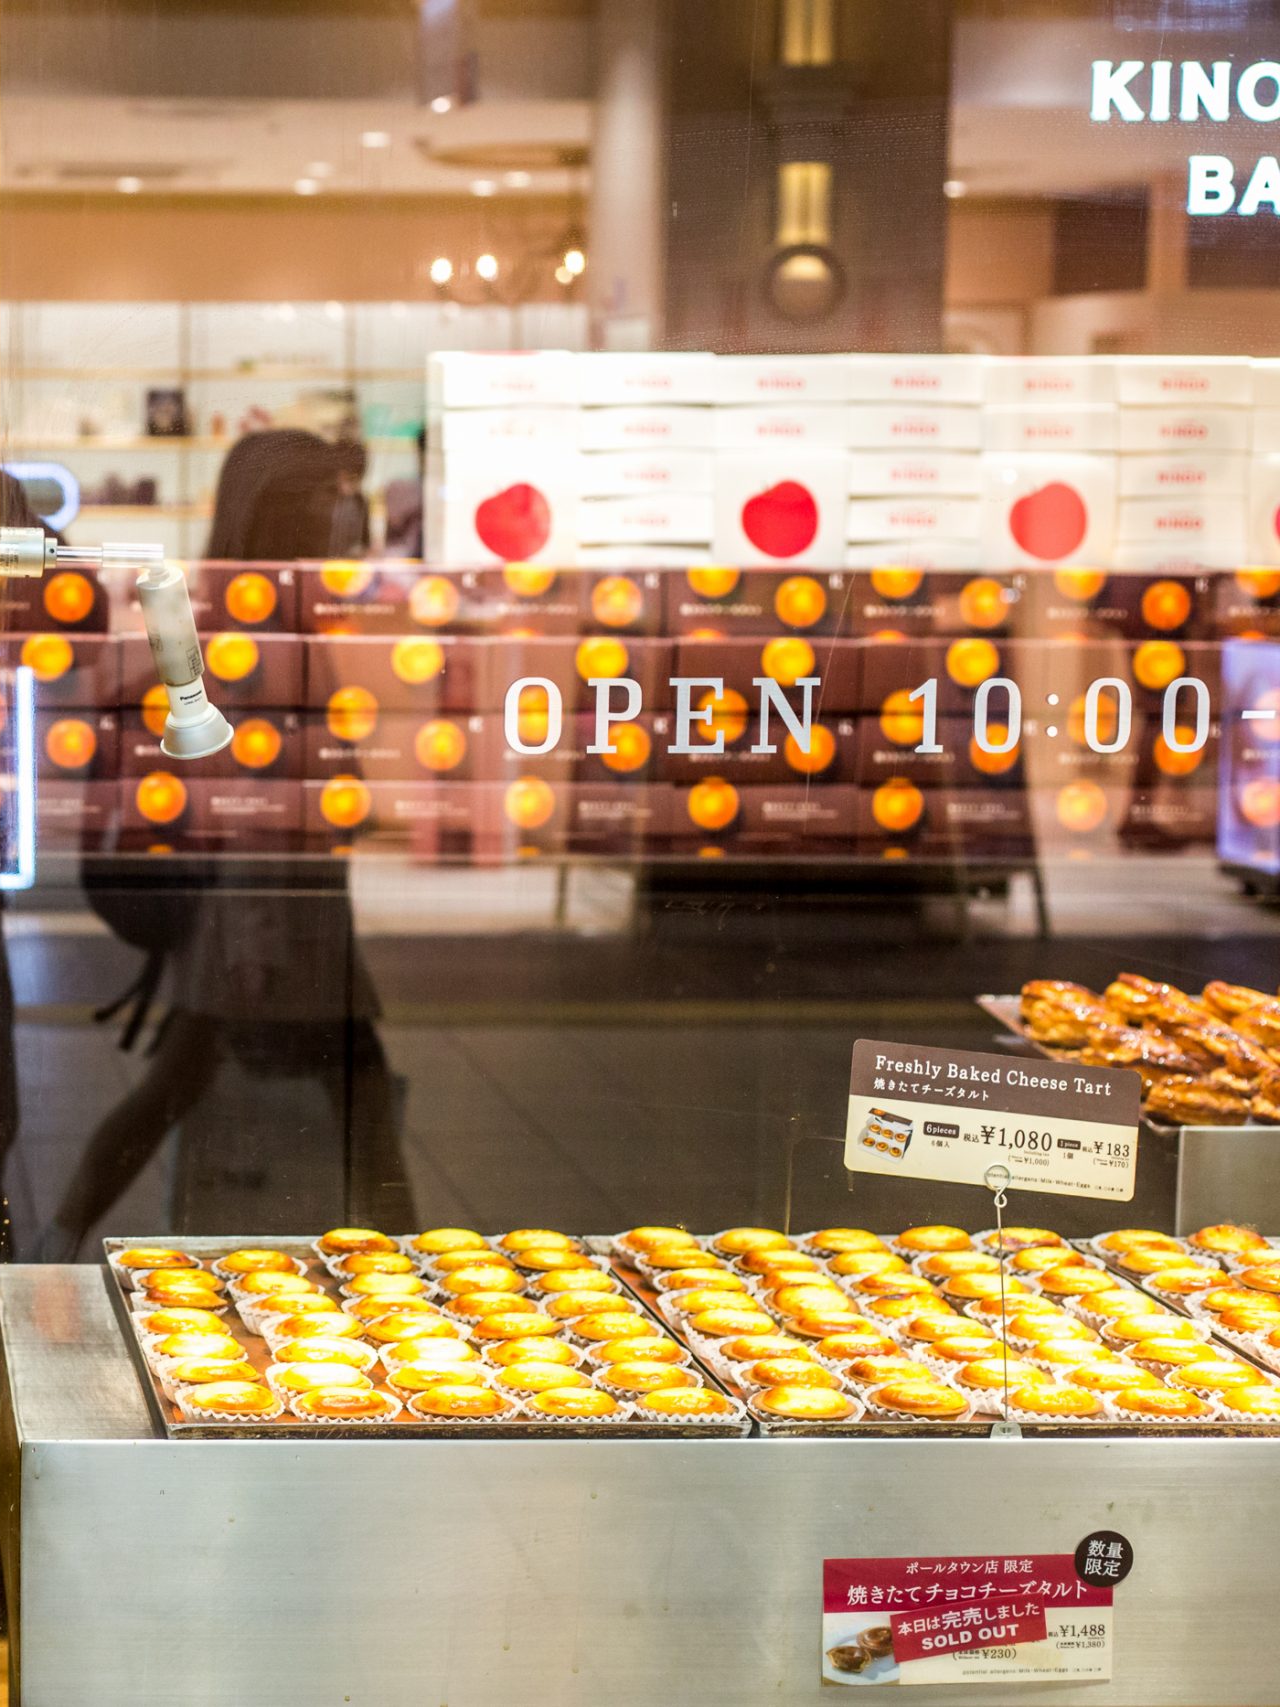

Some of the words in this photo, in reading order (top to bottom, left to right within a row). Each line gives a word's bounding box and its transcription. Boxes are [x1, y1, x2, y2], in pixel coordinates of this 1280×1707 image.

[1089, 60, 1280, 122] KINO
[1187, 155, 1280, 216] BA
[504, 677, 821, 754] OPEN
[875, 1055, 942, 1079] Freshly
[947, 1063, 1001, 1084] Baked
[1006, 1070, 1068, 1091] Cheese
[1073, 1078, 1112, 1096] Tart
[873, 1077, 989, 1102] 焼きたてチーズタルト
[980, 1125, 1052, 1152] ¥1,080
[1087, 1539, 1124, 1559] 数量
[1004, 1559, 1034, 1574] 限定
[1084, 1558, 1121, 1577] 限定
[847, 1580, 1088, 1606] 焼きたてチョコチーズタルト
[897, 1602, 1040, 1636] 本日は完売しました
[1059, 1624, 1106, 1638] ¥1,488
[921, 1630, 973, 1650] SOLD
[978, 1624, 1019, 1640] OUT
